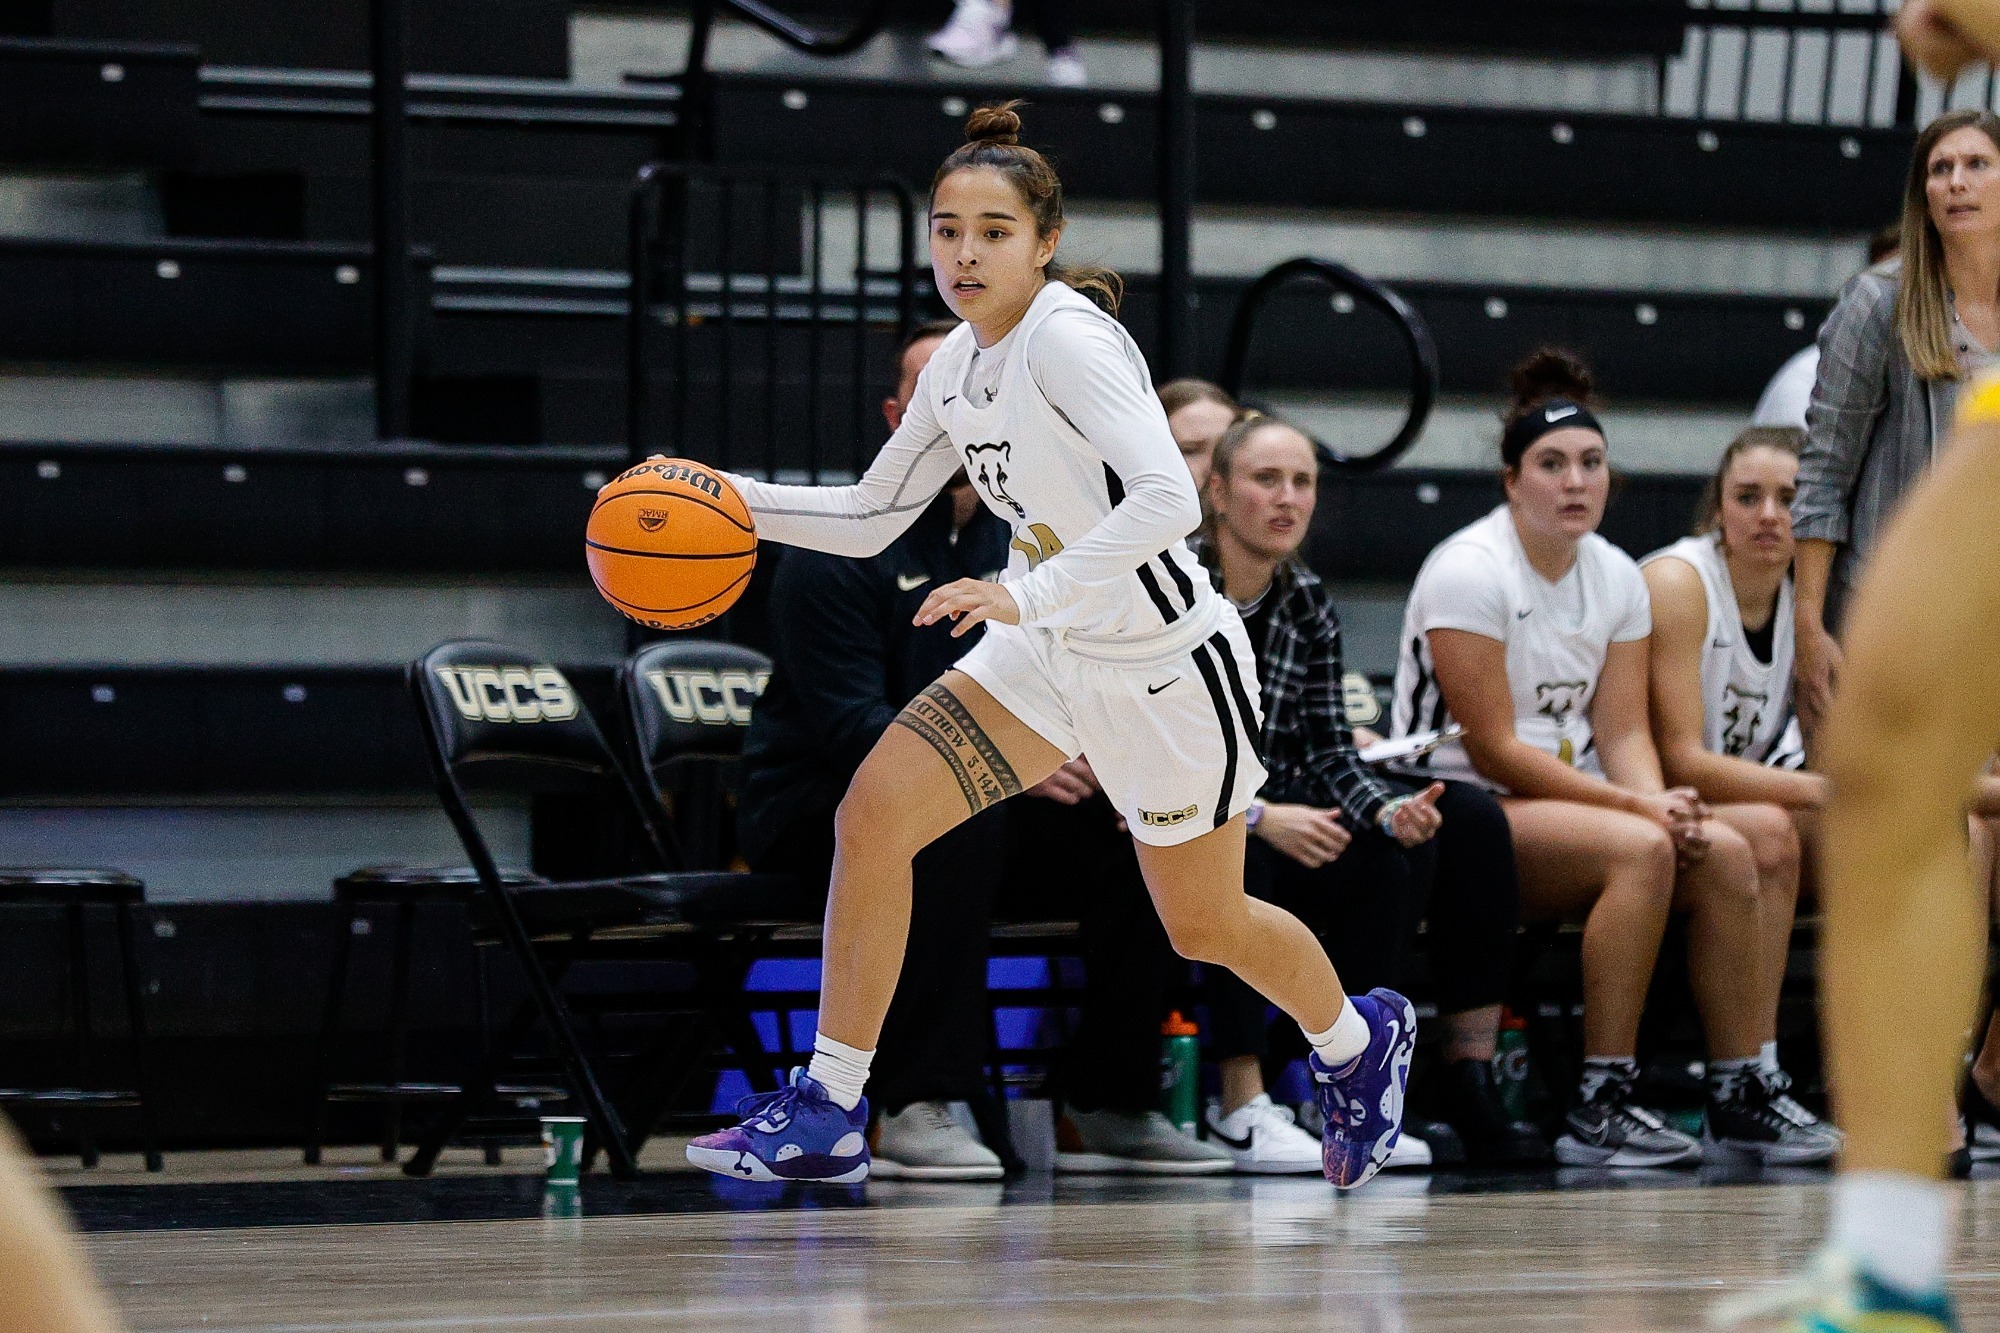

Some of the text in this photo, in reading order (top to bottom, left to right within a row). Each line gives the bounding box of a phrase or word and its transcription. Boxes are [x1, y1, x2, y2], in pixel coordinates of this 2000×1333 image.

[617, 464, 722, 501] Wilson
[435, 667, 580, 724] UCCS
[1137, 804, 1199, 827] UCCS
